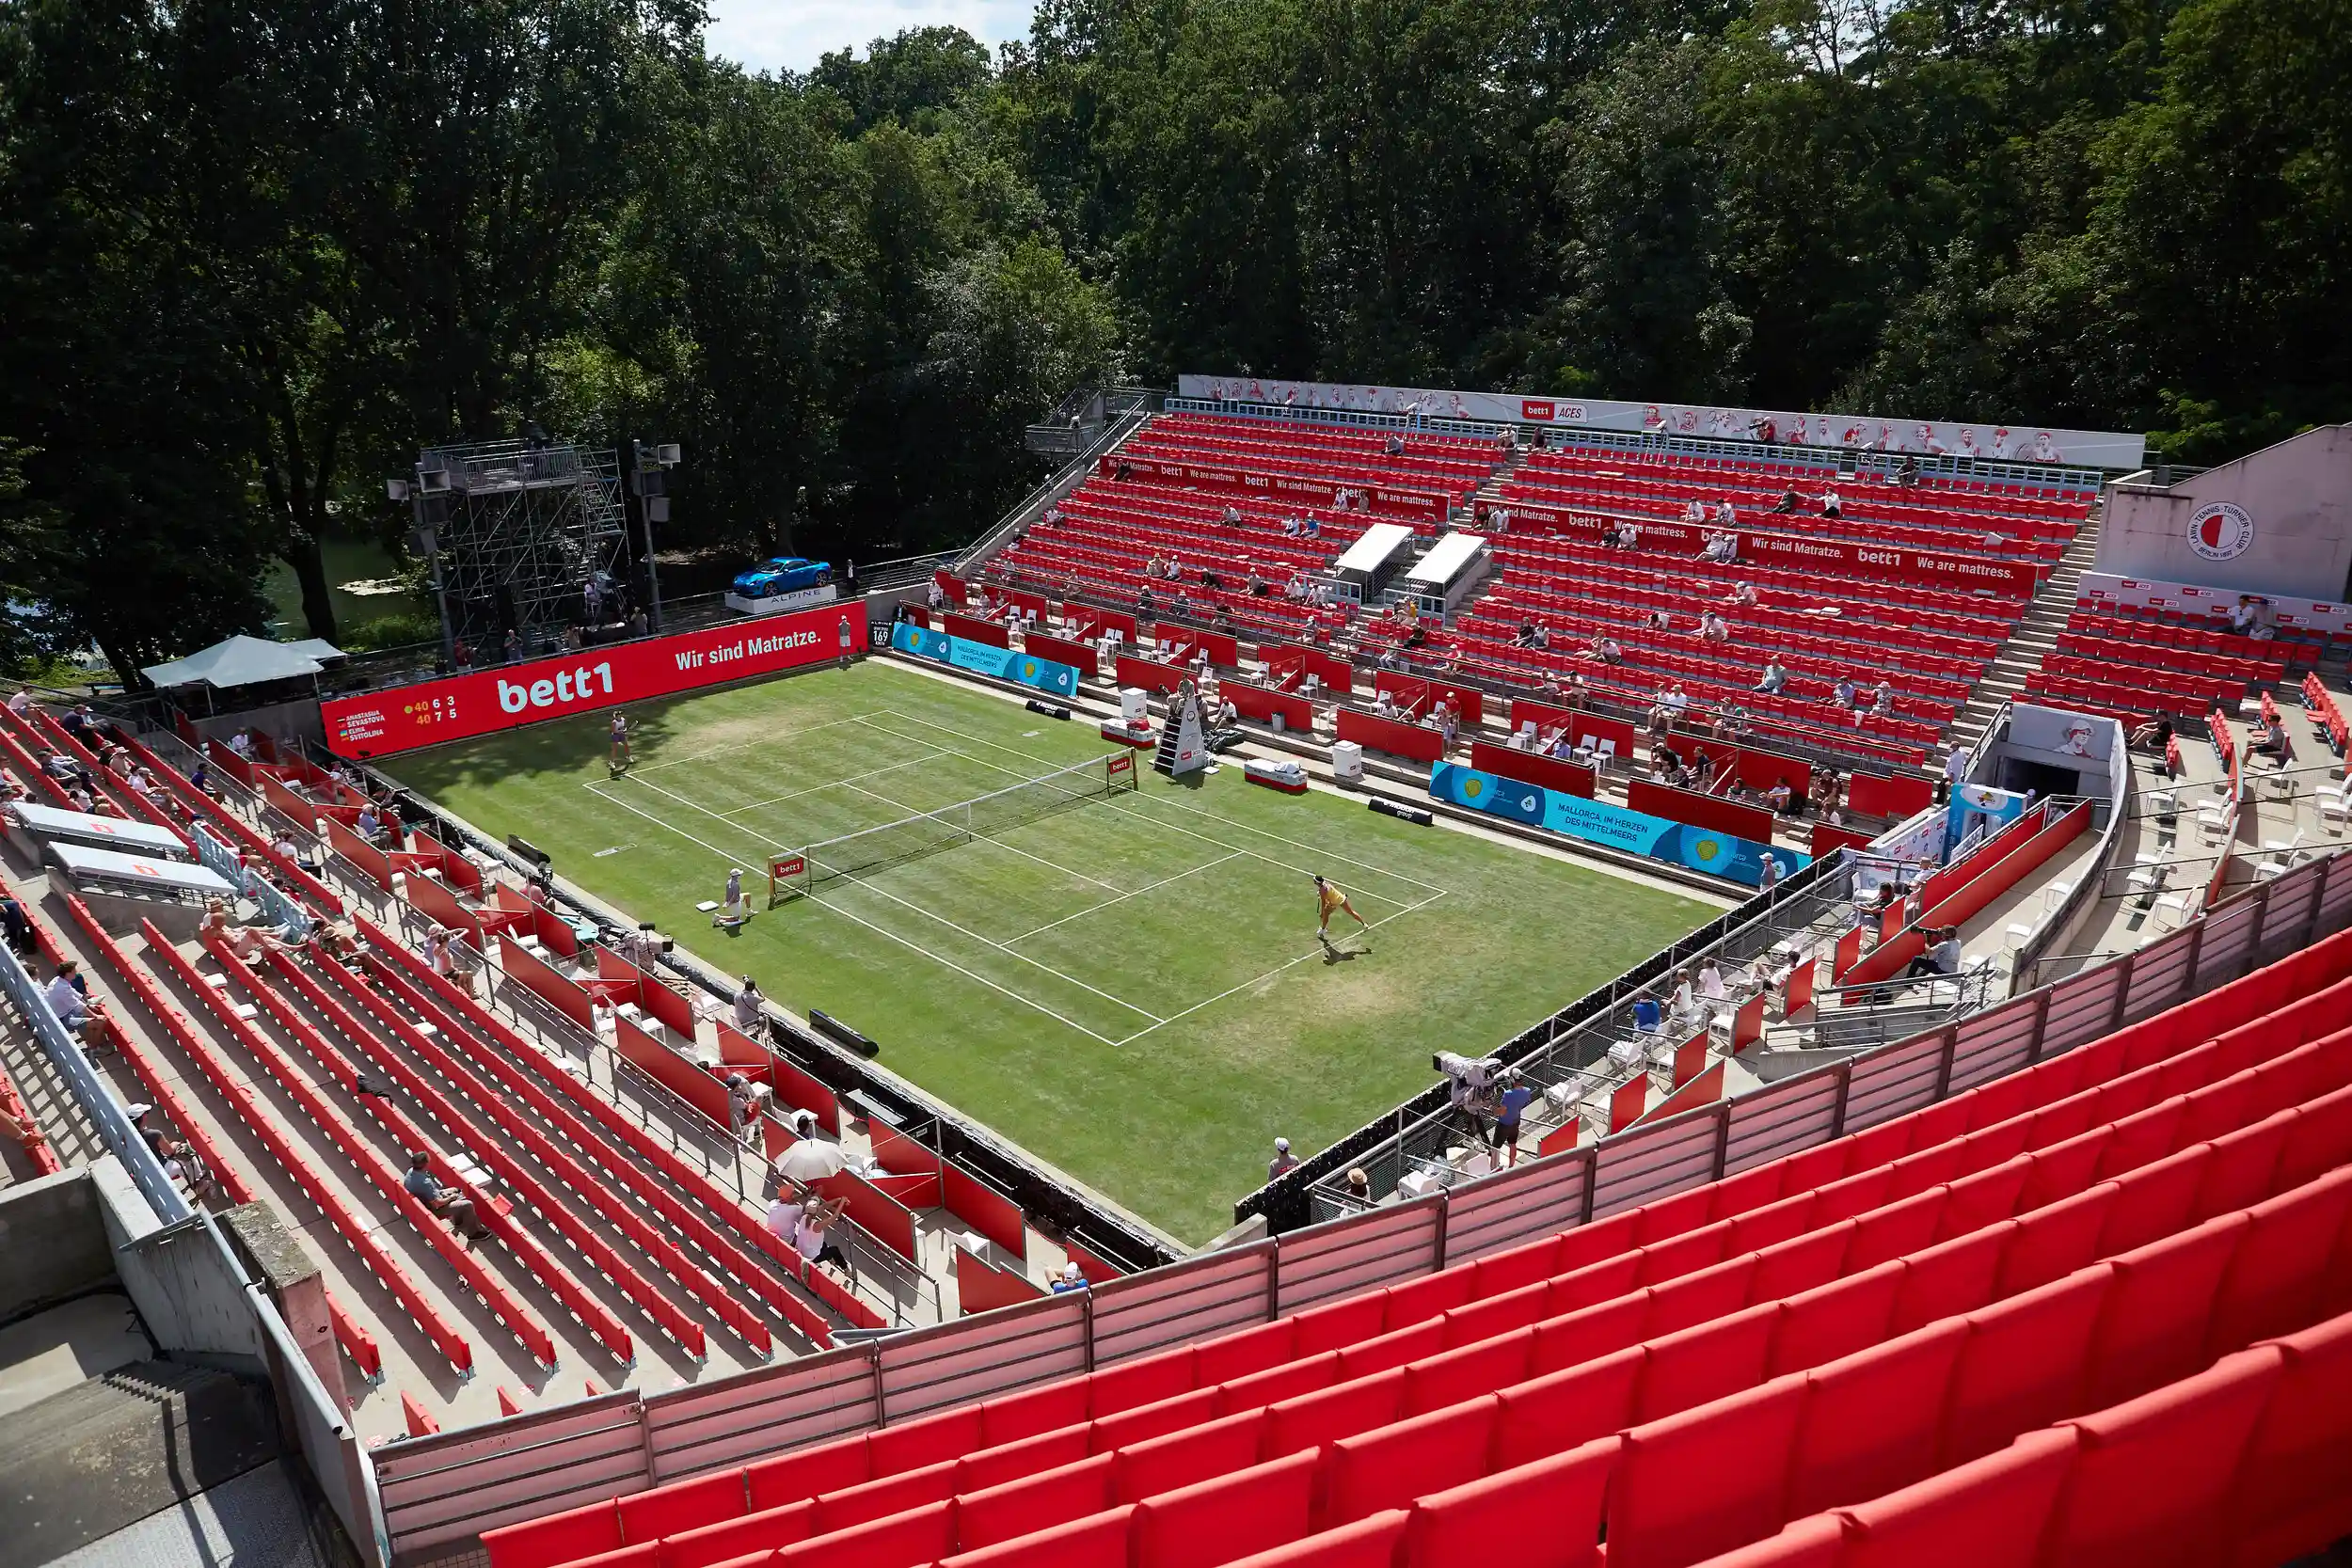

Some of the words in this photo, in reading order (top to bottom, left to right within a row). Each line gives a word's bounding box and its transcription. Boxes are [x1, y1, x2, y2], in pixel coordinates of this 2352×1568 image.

[1527, 405, 1549, 416] bett1
[1558, 407, 1582, 419] ACES
[1161, 465, 1183, 477] bett1
[1189, 469, 1200, 478] We
[1209, 471, 1237, 483] mattress.
[1245, 475, 1268, 487] bett1
[1277, 479, 1287, 489] Wir
[1288, 481, 1302, 491] sind
[1303, 483, 1333, 495] Matratze.
[1377, 491, 1389, 501] We
[1390, 493, 1401, 502] are
[1402, 495, 1436, 508] mattress.
[1520, 508, 1559, 522] Matratze.
[1568, 513, 1601, 529] bett1
[2194, 505, 2220, 522] TENNIS
[2223, 505, 2249, 529] TURNIER
[1645, 526, 1689, 539] mattress.
[1752, 536, 1769, 548] Wir
[1771, 539, 1792, 552] sind
[1794, 543, 1844, 559] Matratze.
[1857, 547, 1901, 566] bett1
[1916, 556, 1934, 569] We
[1936, 560, 1956, 572] are
[1958, 562, 2014, 579] mattress.
[771, 589, 821, 603] ALPINE
[873, 630, 888, 641] 169
[675, 651, 705, 671] Wir
[708, 641, 744, 664] sind
[747, 629, 822, 656] Matratze.
[497, 661, 613, 714] bett1
[414, 701, 429, 712] 40
[432, 699, 440, 708] 6
[447, 695, 455, 705] 3
[416, 714, 431, 725] 40
[435, 711, 442, 721] 7
[449, 708, 457, 719] 5
[1112, 760, 1128, 770] bett1
[1565, 816, 1581, 827] DES
[1581, 821, 1637, 842] MITTELMEERS
[1603, 816, 1613, 825] IM
[1614, 817, 1648, 833] HERZEN
[780, 863, 800, 874] bett1
